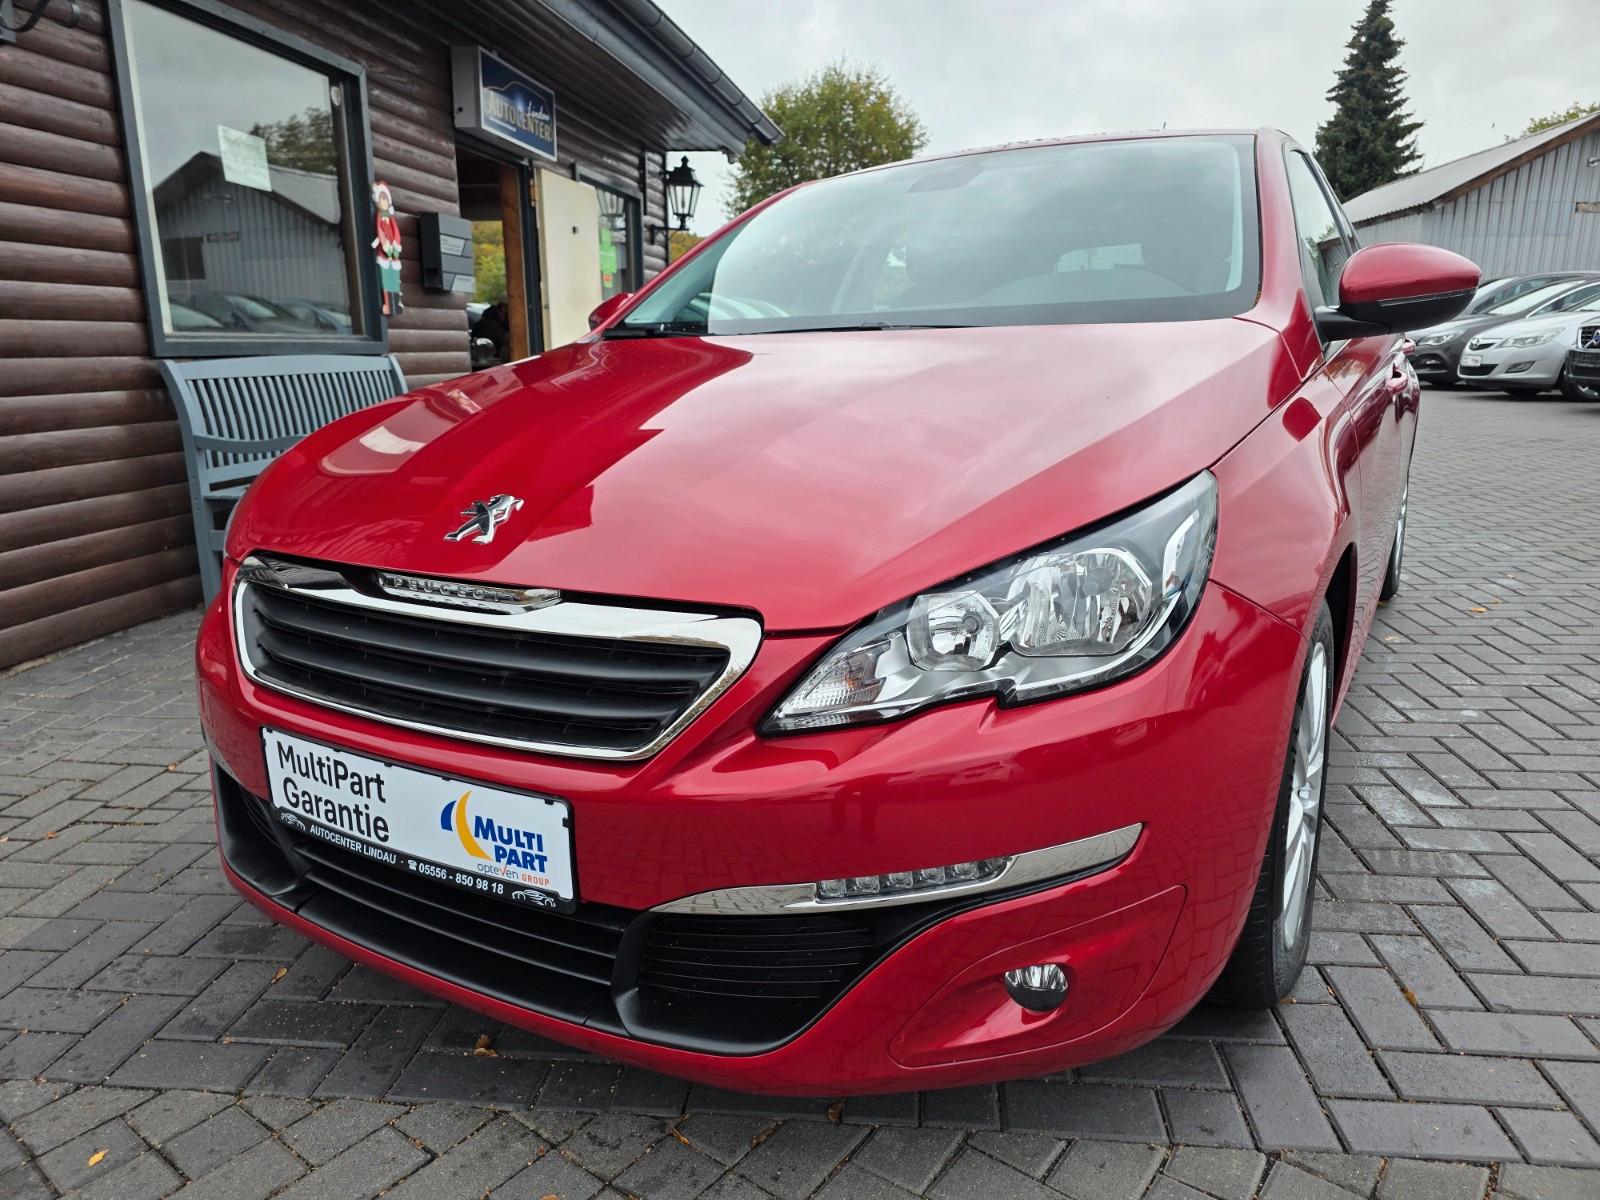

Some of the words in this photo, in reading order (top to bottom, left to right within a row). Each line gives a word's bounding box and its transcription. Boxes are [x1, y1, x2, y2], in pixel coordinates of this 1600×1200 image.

[394, 575, 505, 602] PEUGEOT
[277, 740, 387, 804] MultiPart
[283, 776, 390, 843] Garantie
[474, 815, 544, 853] MULTI
[310, 824, 362, 853] AUTOCENTER
[363, 844, 397, 865] LINDAU
[418, 862, 447, 880] 05556
[455, 873, 474, 887] 850
[475, 878, 489, 891] 98
[491, 882, 504, 895] 18
[477, 863, 519, 880] opteven
[521, 873, 550, 887] GROUP
[494, 844, 548, 874] PART
